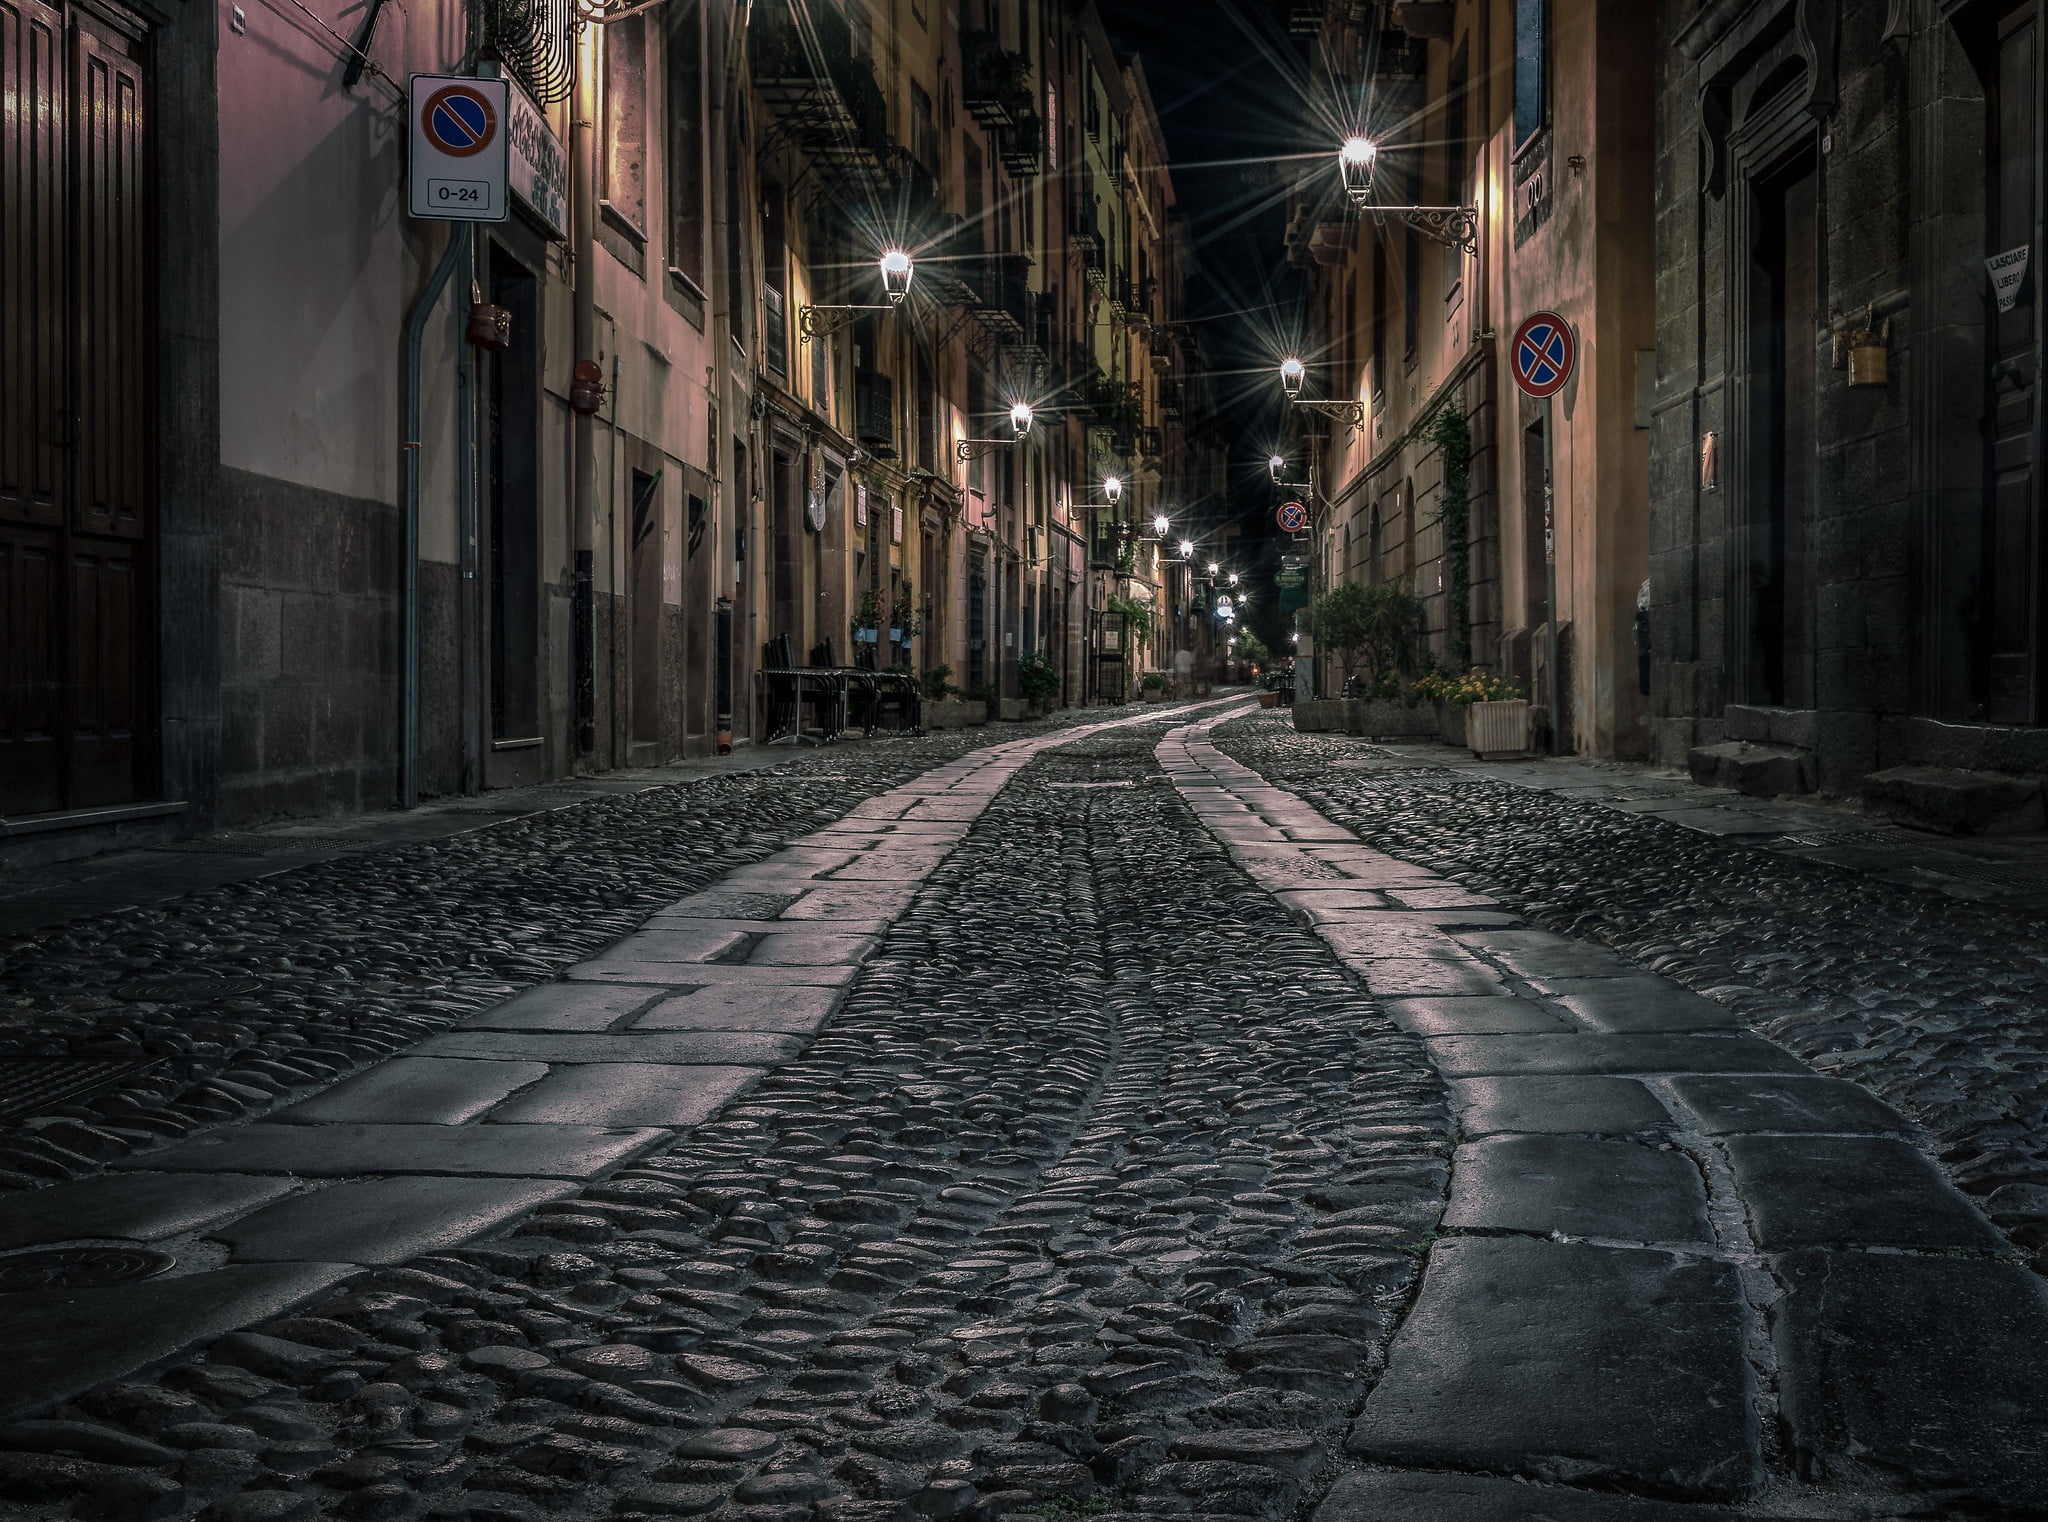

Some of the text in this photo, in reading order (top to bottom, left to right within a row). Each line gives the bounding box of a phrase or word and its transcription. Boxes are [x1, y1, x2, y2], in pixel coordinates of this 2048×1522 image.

[438, 187, 479, 201] 0-24
[1989, 249, 2026, 271] LASCIARE
[1996, 272, 2020, 289] LIBERO
